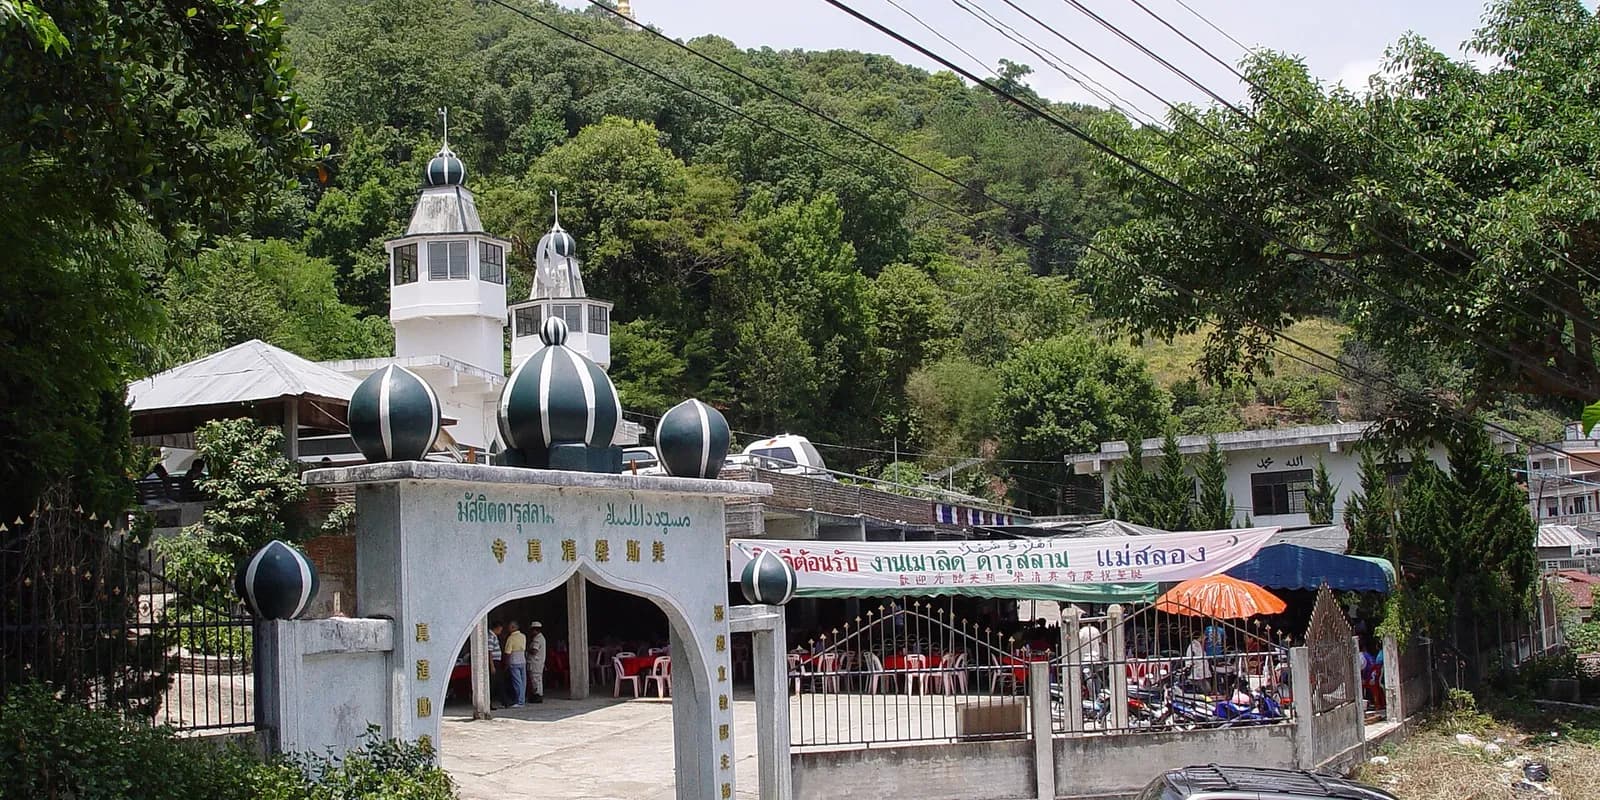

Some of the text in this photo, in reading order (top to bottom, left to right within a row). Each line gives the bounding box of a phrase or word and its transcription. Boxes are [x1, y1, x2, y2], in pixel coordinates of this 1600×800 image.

[752, 547, 858, 572] ิดีต้อนรับ
[977, 550, 1069, 576] ดารุสลาม
[1097, 543, 1206, 568] แม่สลอง
